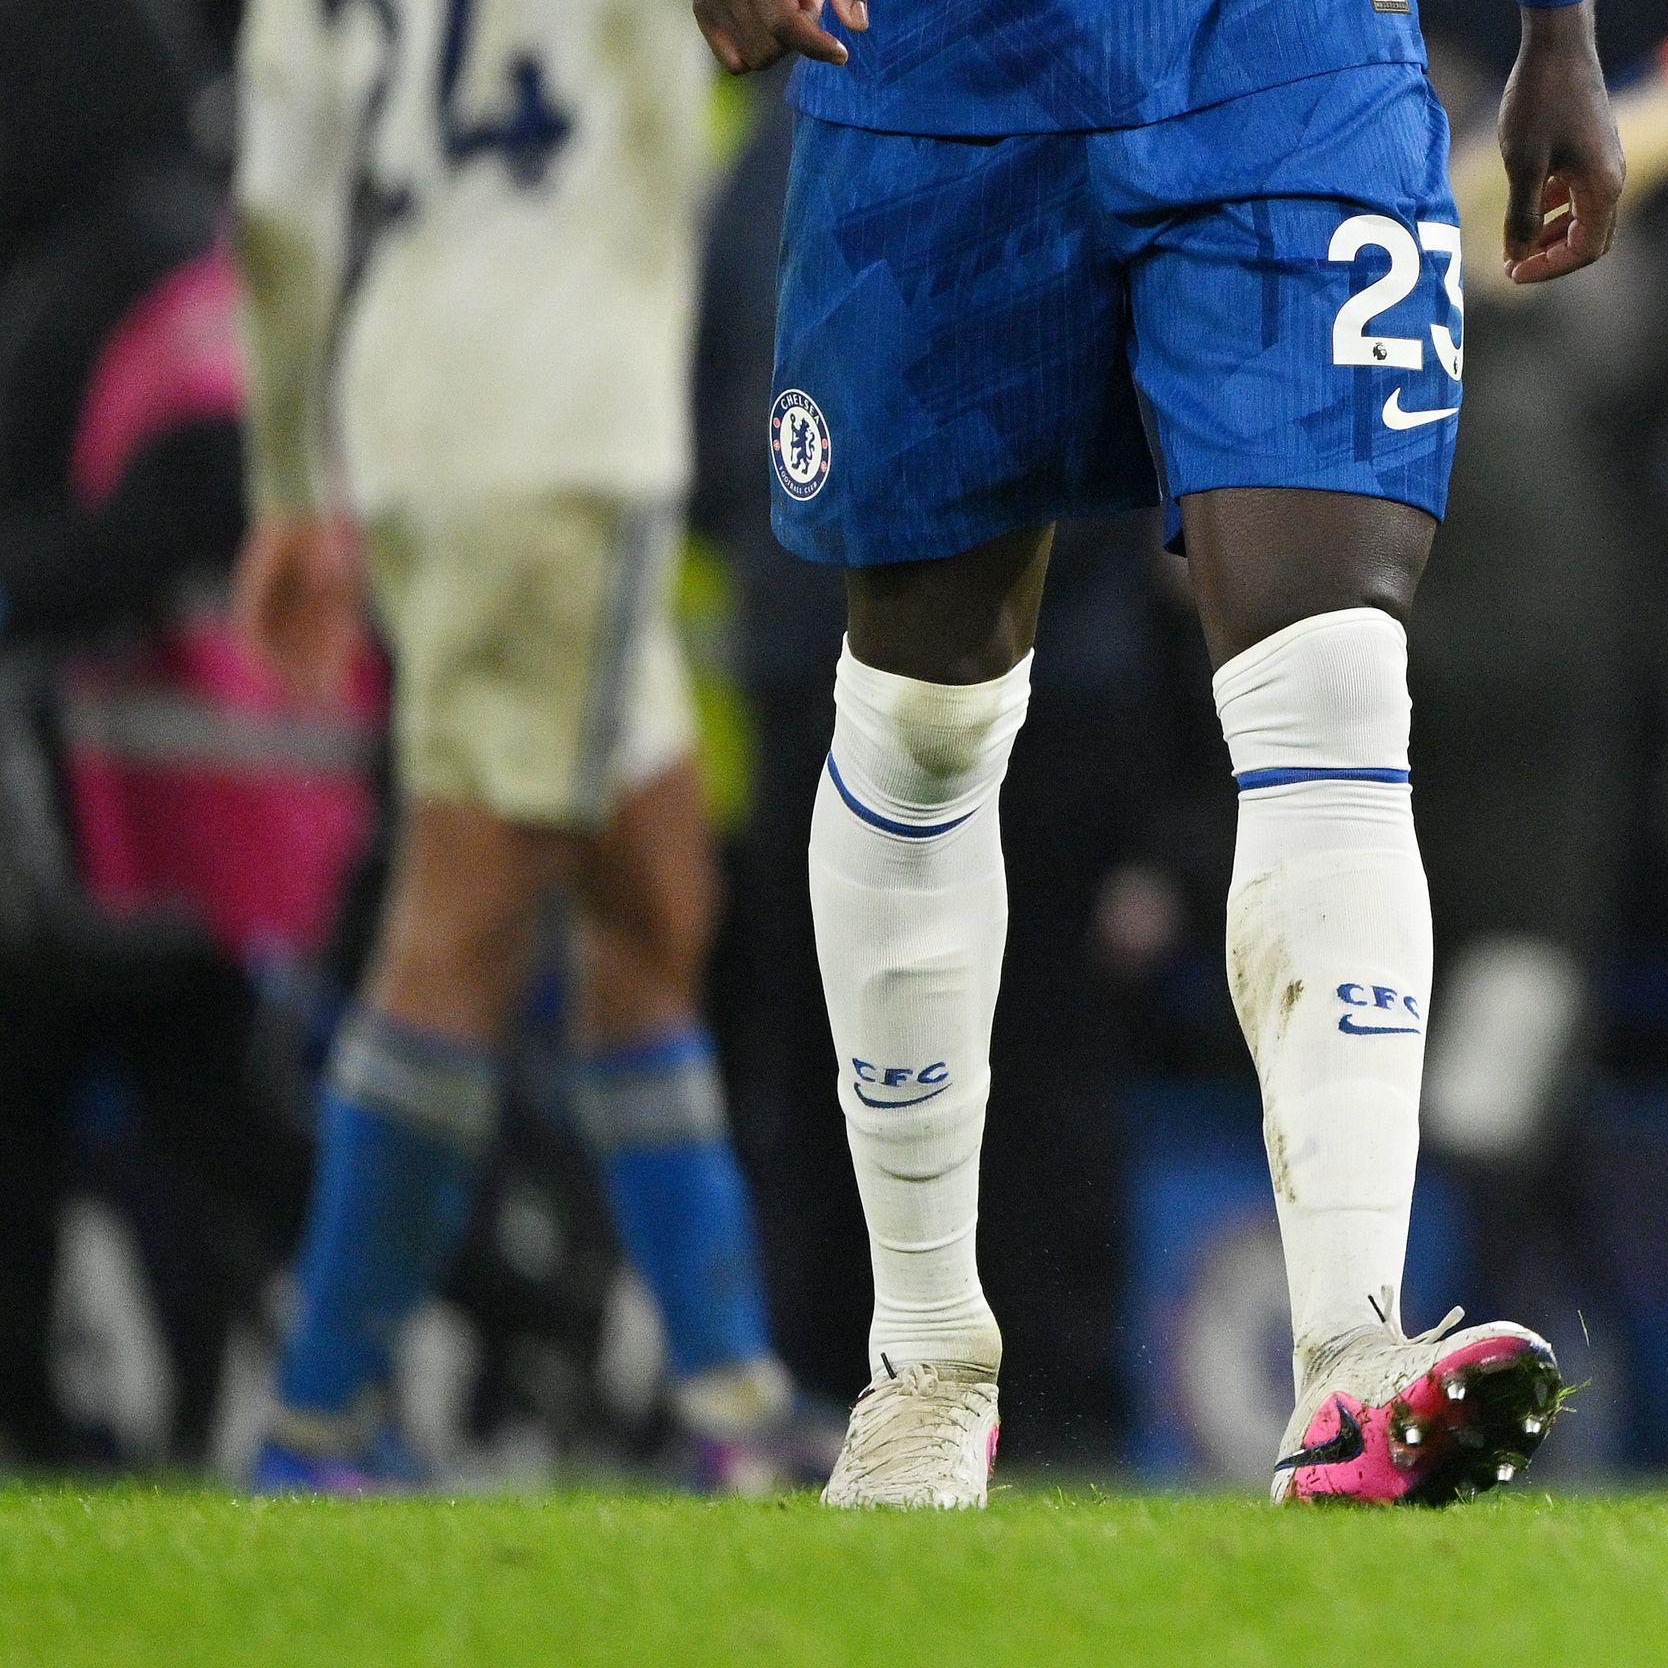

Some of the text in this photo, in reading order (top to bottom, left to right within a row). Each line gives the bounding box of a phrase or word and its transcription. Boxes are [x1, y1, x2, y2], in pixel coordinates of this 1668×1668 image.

[1327, 214, 1463, 381] 23
[781, 394, 820, 425] CHELSEA
[1336, 983, 1420, 1020] CFC
[852, 1058, 949, 1087] CFC
